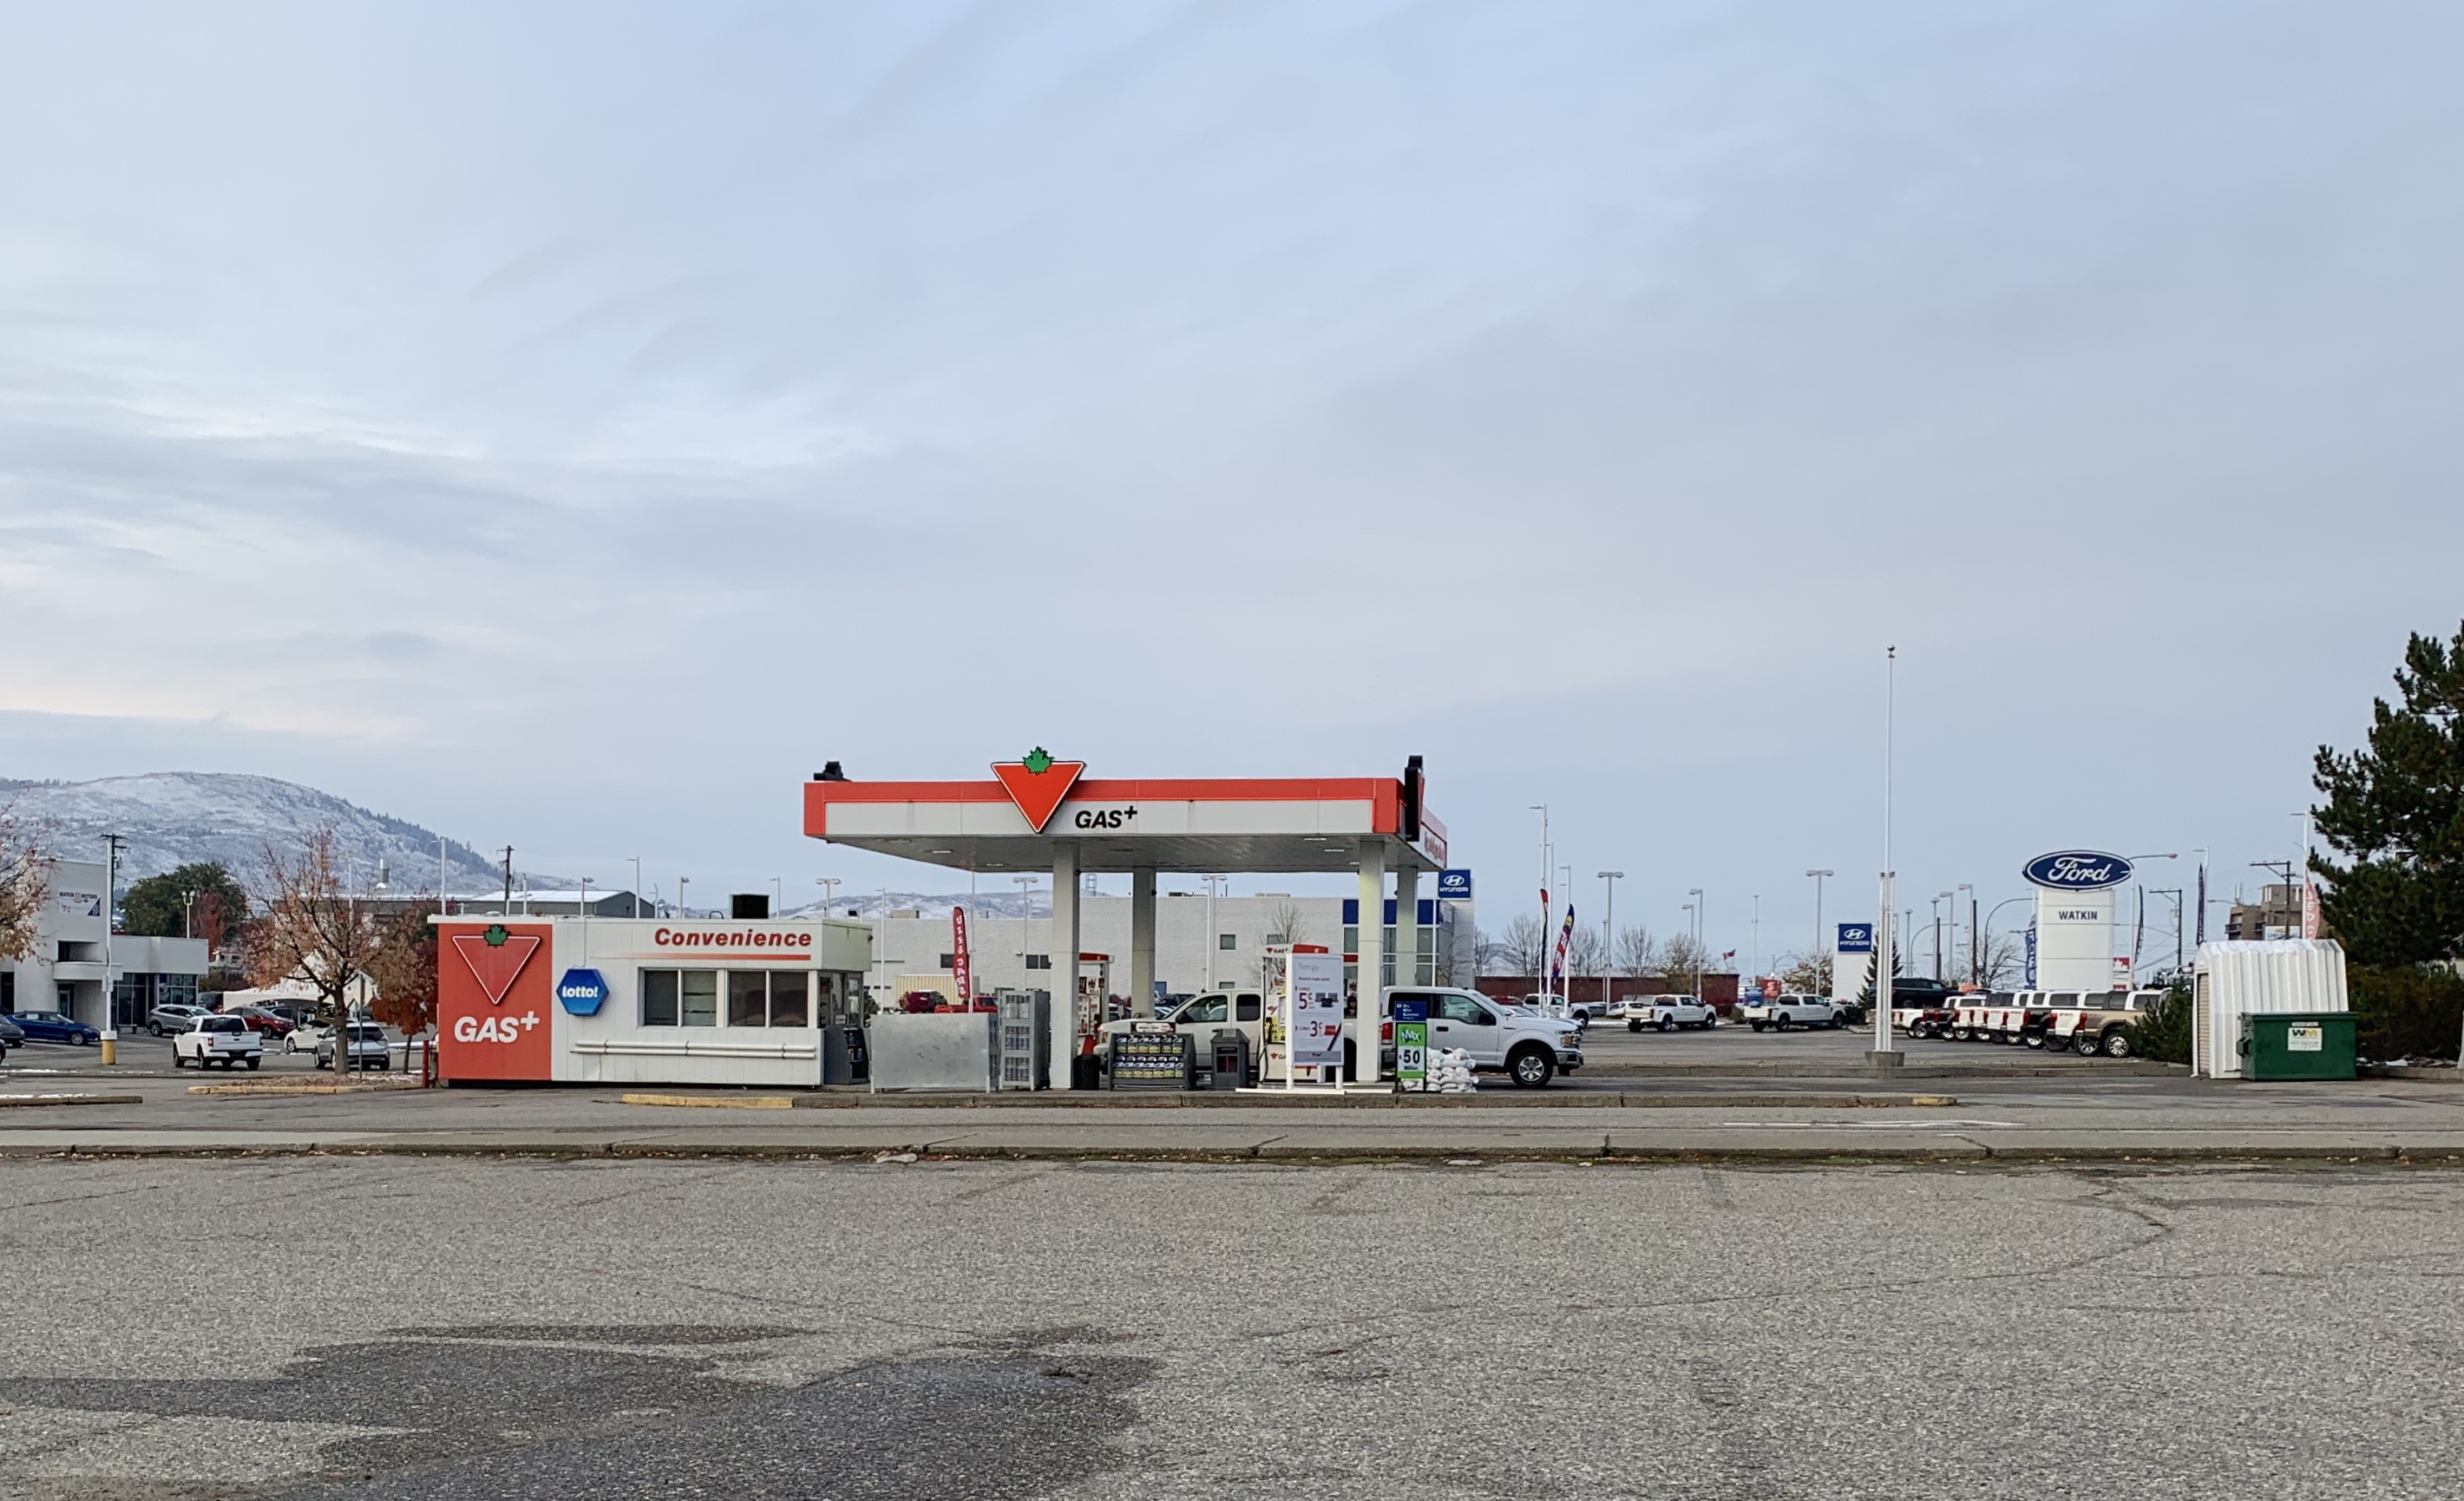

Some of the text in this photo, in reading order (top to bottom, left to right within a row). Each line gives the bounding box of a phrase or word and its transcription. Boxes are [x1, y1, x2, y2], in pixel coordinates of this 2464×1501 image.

[1075, 805, 1137, 829] GAS+
[2048, 856, 2113, 882] Ford
[2059, 910, 2098, 920] WATKIN
[655, 927, 811, 947] Convenience
[562, 986, 599, 998] lotto!
[455, 1011, 540, 1043] GAS+
[1401, 1030, 1420, 1042] MAX
